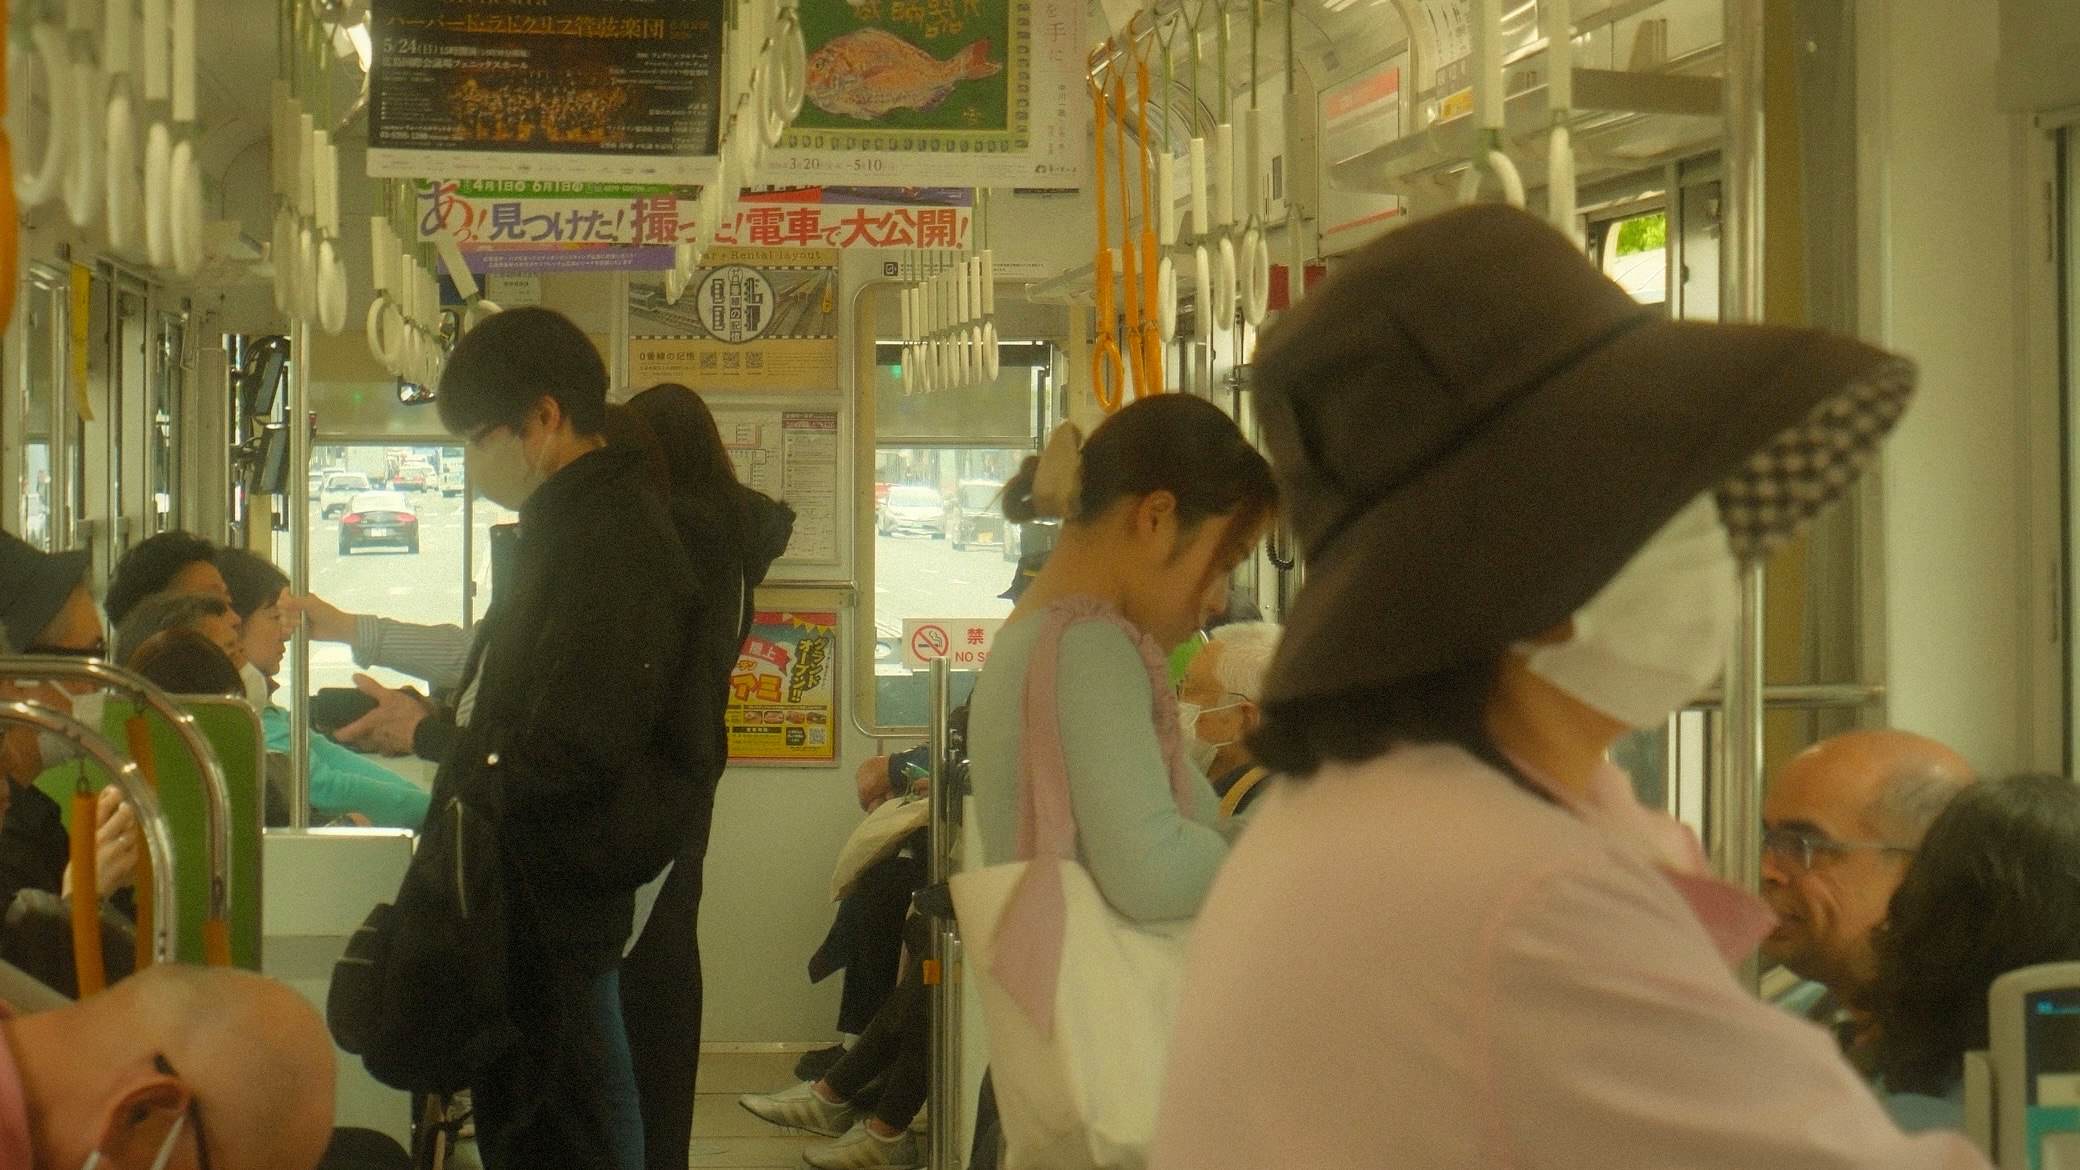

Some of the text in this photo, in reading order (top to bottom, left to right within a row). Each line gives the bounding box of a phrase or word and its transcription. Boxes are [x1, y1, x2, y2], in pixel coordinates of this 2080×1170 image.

[730, 250, 772, 260] Rental
[779, 250, 821, 261] layout
[955, 651, 974, 662] NO
